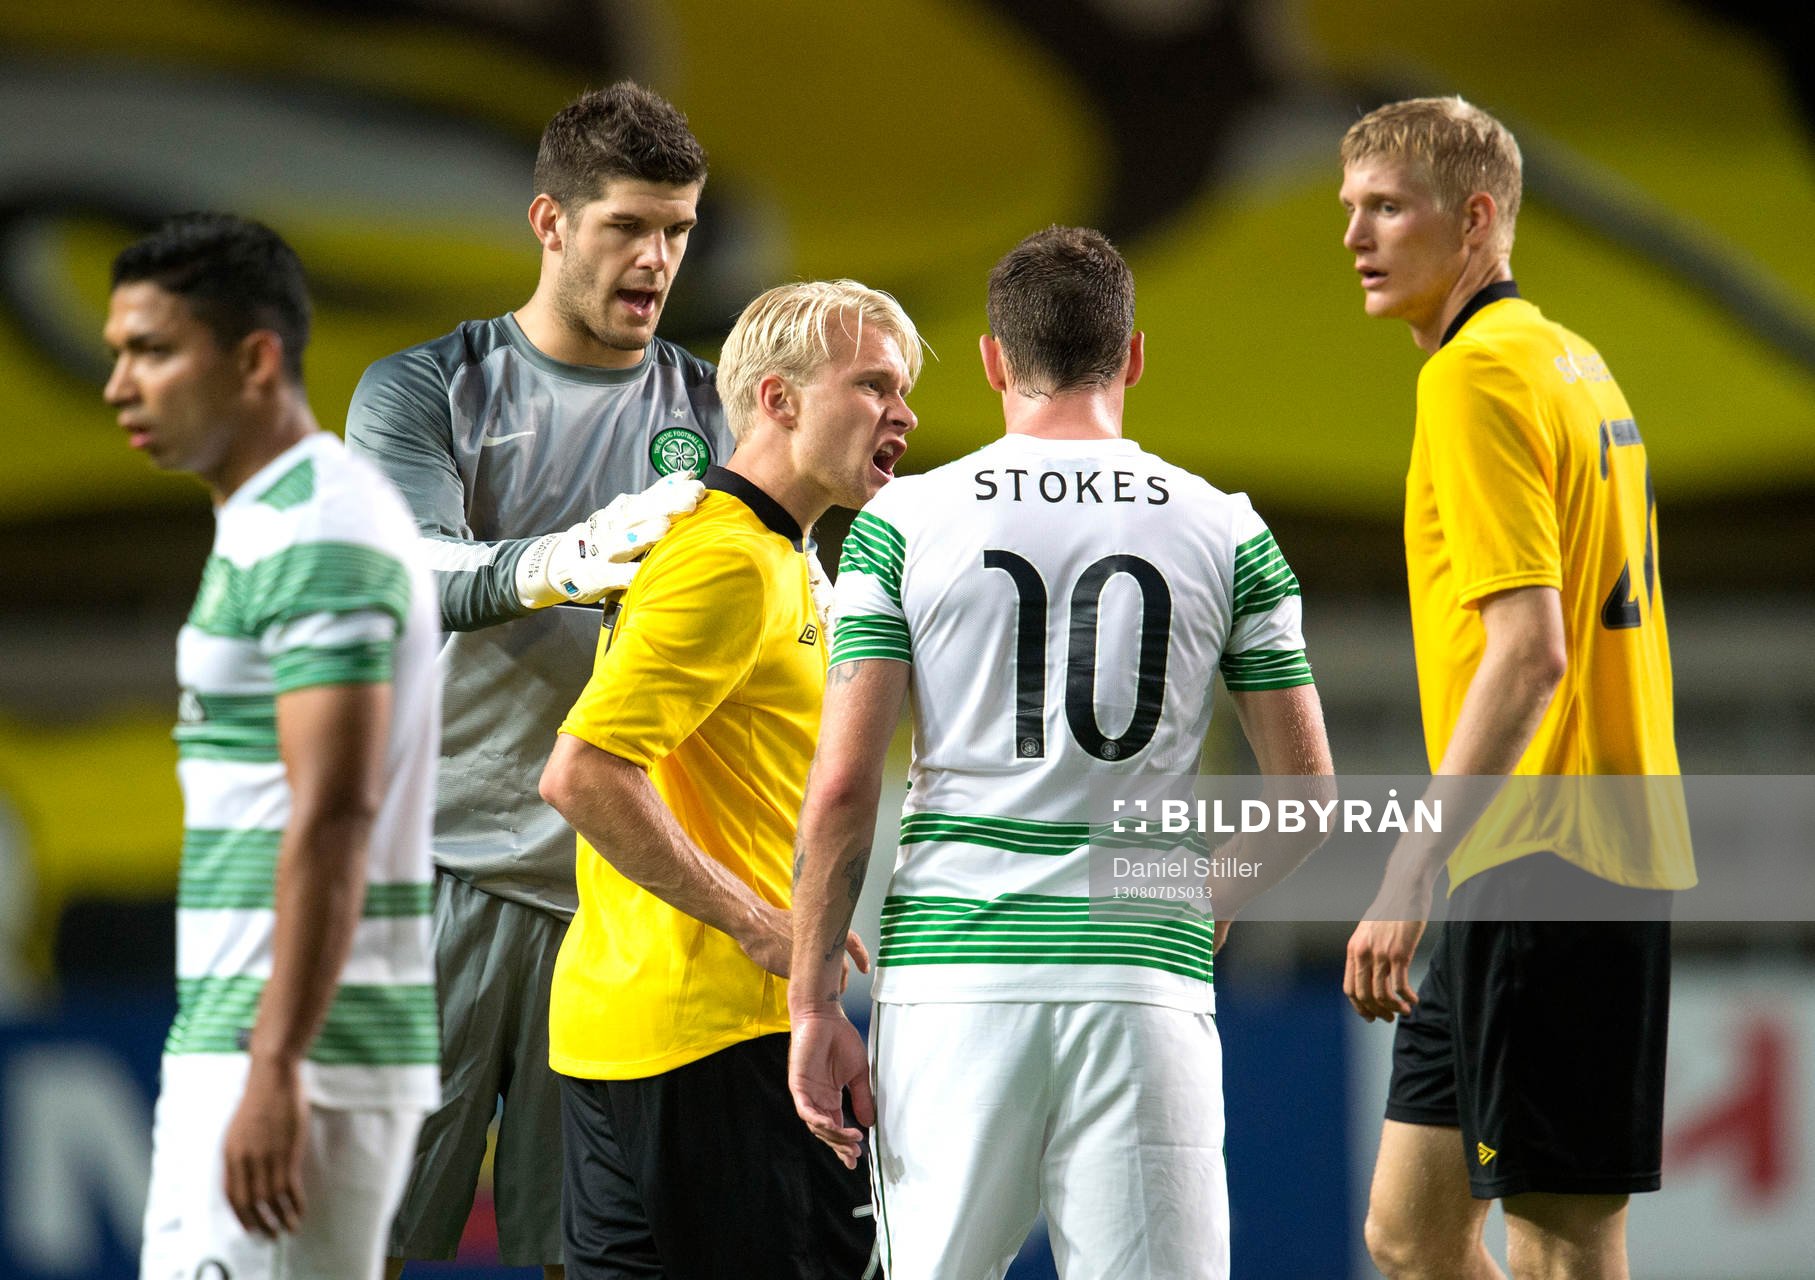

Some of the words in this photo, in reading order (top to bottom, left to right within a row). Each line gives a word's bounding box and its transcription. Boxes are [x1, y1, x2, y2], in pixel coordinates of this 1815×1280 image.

[673, 430, 699, 445] FOOTBALL
[974, 469, 1170, 505] STOKES
[983, 549, 1172, 762] 10
